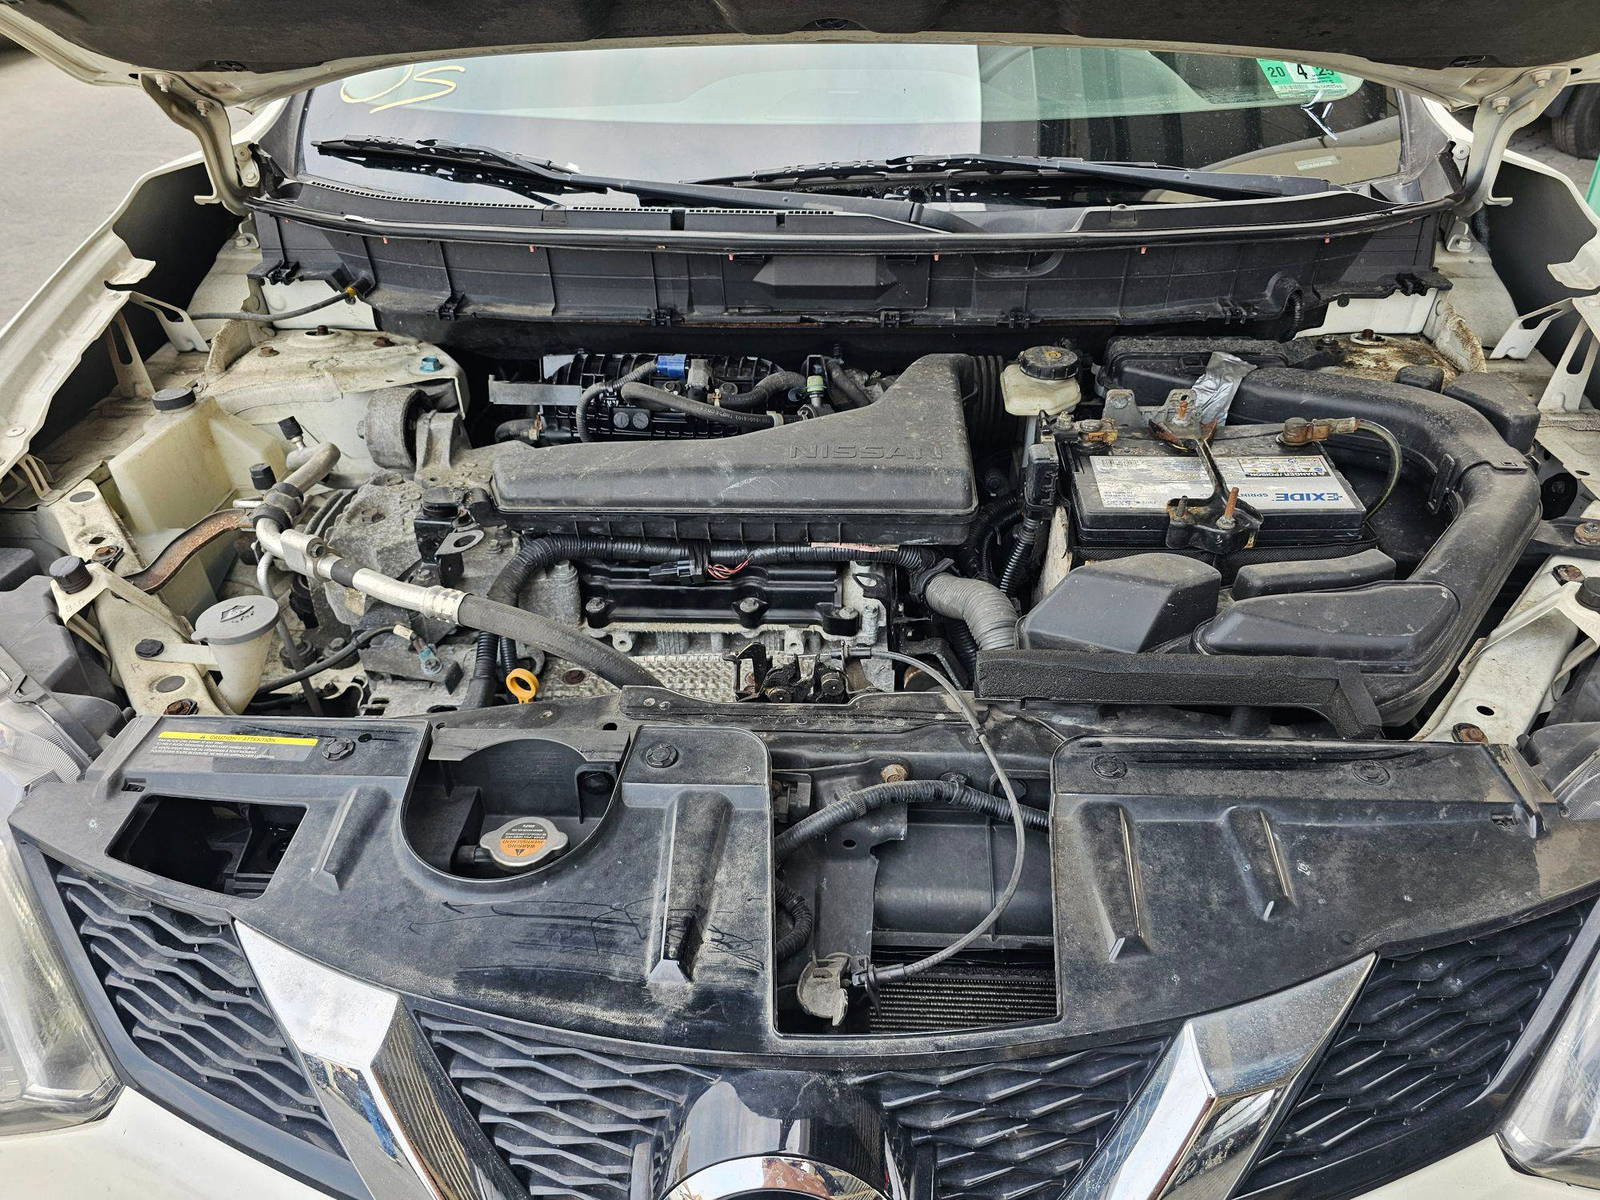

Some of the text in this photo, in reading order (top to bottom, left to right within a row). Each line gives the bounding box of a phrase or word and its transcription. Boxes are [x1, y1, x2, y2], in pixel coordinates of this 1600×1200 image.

[1267, 66, 1286, 78] 20
[790, 444, 944, 460] NISSAN
[1275, 492, 1342, 502] EXIDE
